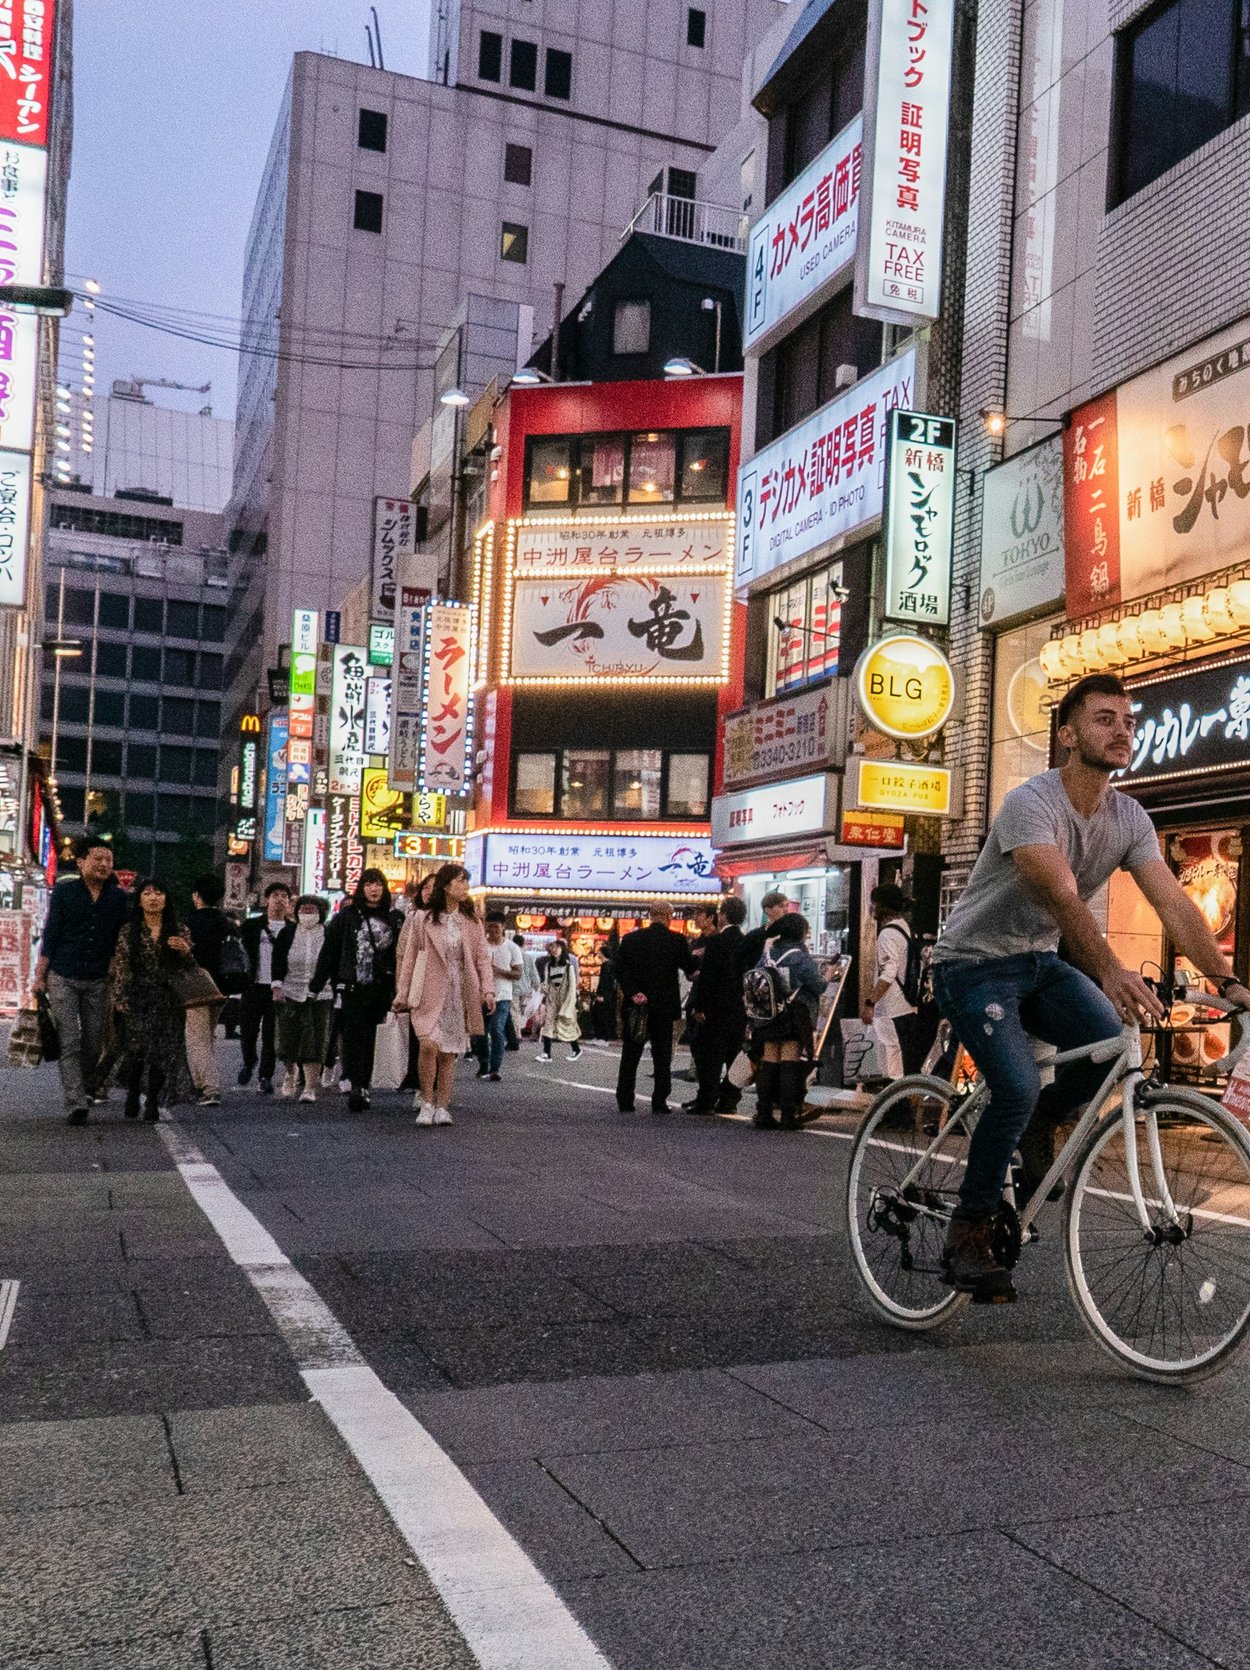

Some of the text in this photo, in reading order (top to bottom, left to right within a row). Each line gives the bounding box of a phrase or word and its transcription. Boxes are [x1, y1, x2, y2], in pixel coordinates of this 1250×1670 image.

[896, 100, 924, 213] 証明写真
[885, 219, 927, 237] KITAMURA
[885, 228, 927, 246] CAMERA
[800, 227, 856, 283] USED CAMERA
[885, 242, 925, 268] TAX
[883, 260, 925, 283] FREE
[882, 375, 911, 409] TAX
[910, 419, 942, 445] 2F
[904, 447, 944, 474] 新橋
[1126, 477, 1166, 522] 新橋
[741, 488, 753, 563] 3F
[769, 526, 794, 551] DIGITAL
[795, 510, 823, 537] CAMERA
[838, 484, 866, 511] PHOTO
[523, 544, 723, 567] 中洲屋台ラーメン
[1001, 532, 1051, 568] TOKYO
[898, 590, 939, 615] 酒場
[431, 635, 466, 755] ラーメン
[869, 672, 923, 701] BLG
[868, 776, 942, 792] 一口餃子酒場
[879, 788, 930, 800] GYOZA PUB
[344, 796, 364, 896] ヨドバシカメラ
[508, 845, 639, 858] 昭和30年創業 元祖博多
[492, 861, 653, 881] 中洲屋台ラーメン
